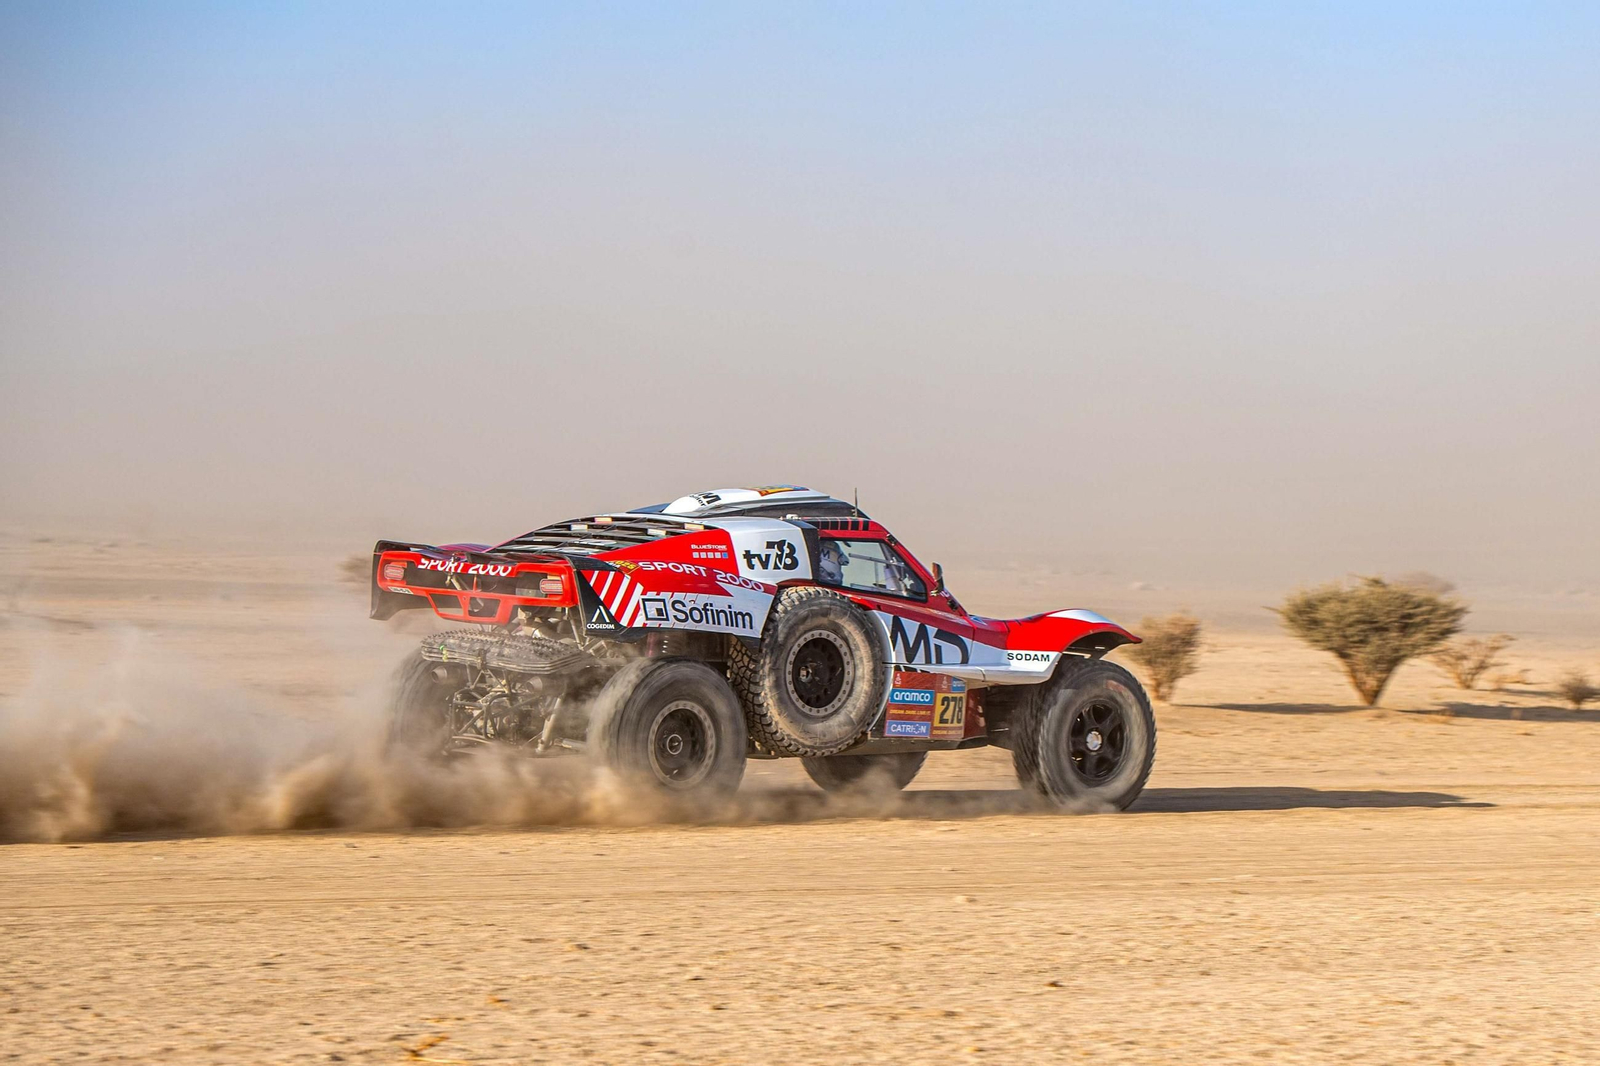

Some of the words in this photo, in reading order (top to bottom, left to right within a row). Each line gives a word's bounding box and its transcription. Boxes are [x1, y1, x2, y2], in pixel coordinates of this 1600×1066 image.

[417, 558, 465, 574] SPORT
[468, 563, 512, 577] 2000
[638, 561, 707, 577] SPORT
[713, 569, 765, 592] 2000
[671, 599, 753, 630] Sofinim
[1007, 652, 1050, 662] SODAM
[893, 691, 931, 702] aramco
[938, 696, 963, 724] 278
[890, 724, 927, 734] CATRION
